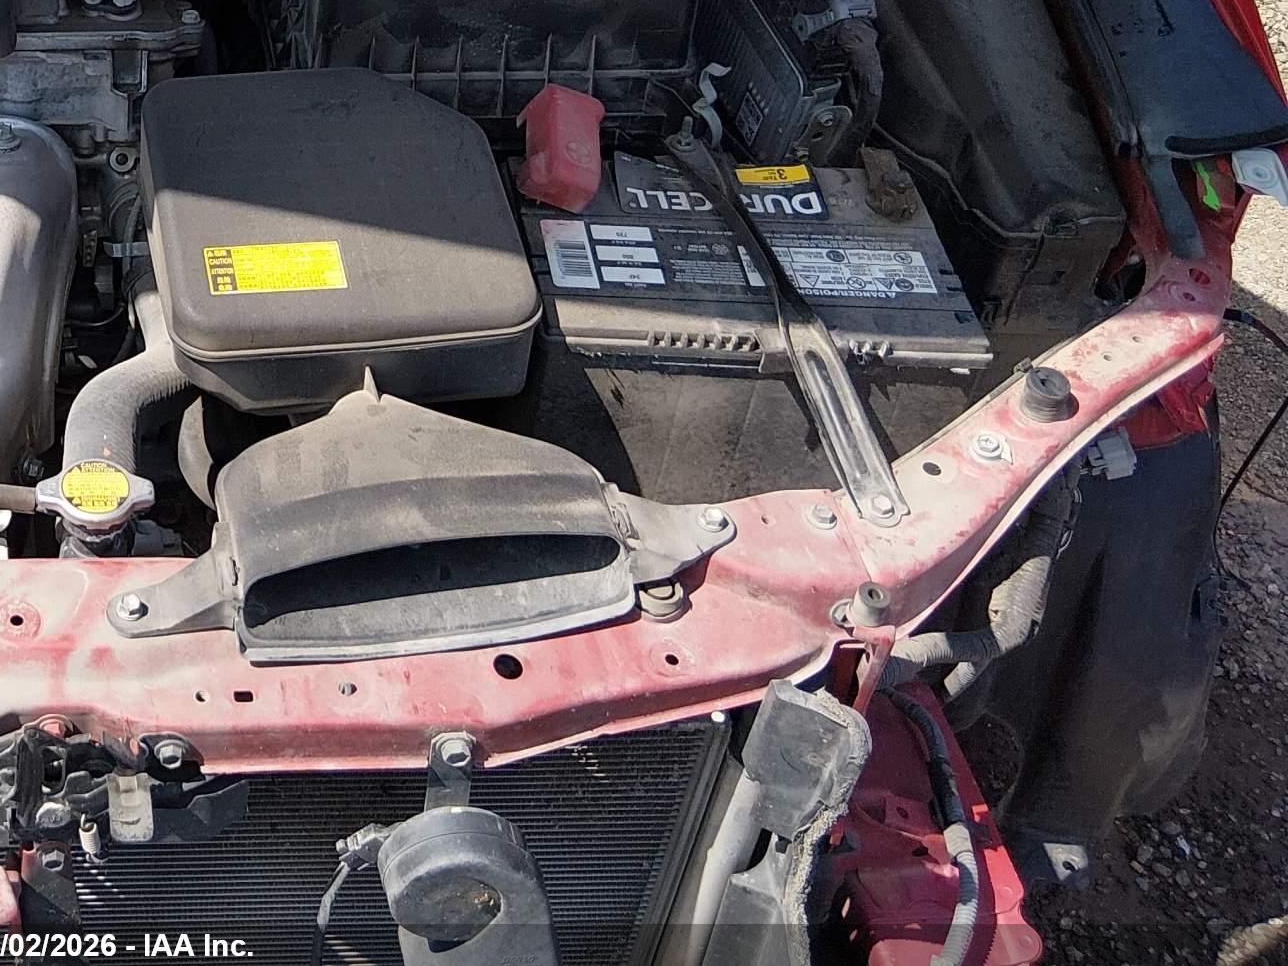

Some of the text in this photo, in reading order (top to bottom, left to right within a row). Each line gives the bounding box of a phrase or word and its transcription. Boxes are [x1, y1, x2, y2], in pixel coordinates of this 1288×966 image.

[776, 169, 788, 180] 3
[626, 187, 823, 214] DURCELL
[208, 257, 233, 266] CAUTION
[797, 288, 885, 298] DANGER/POISON
